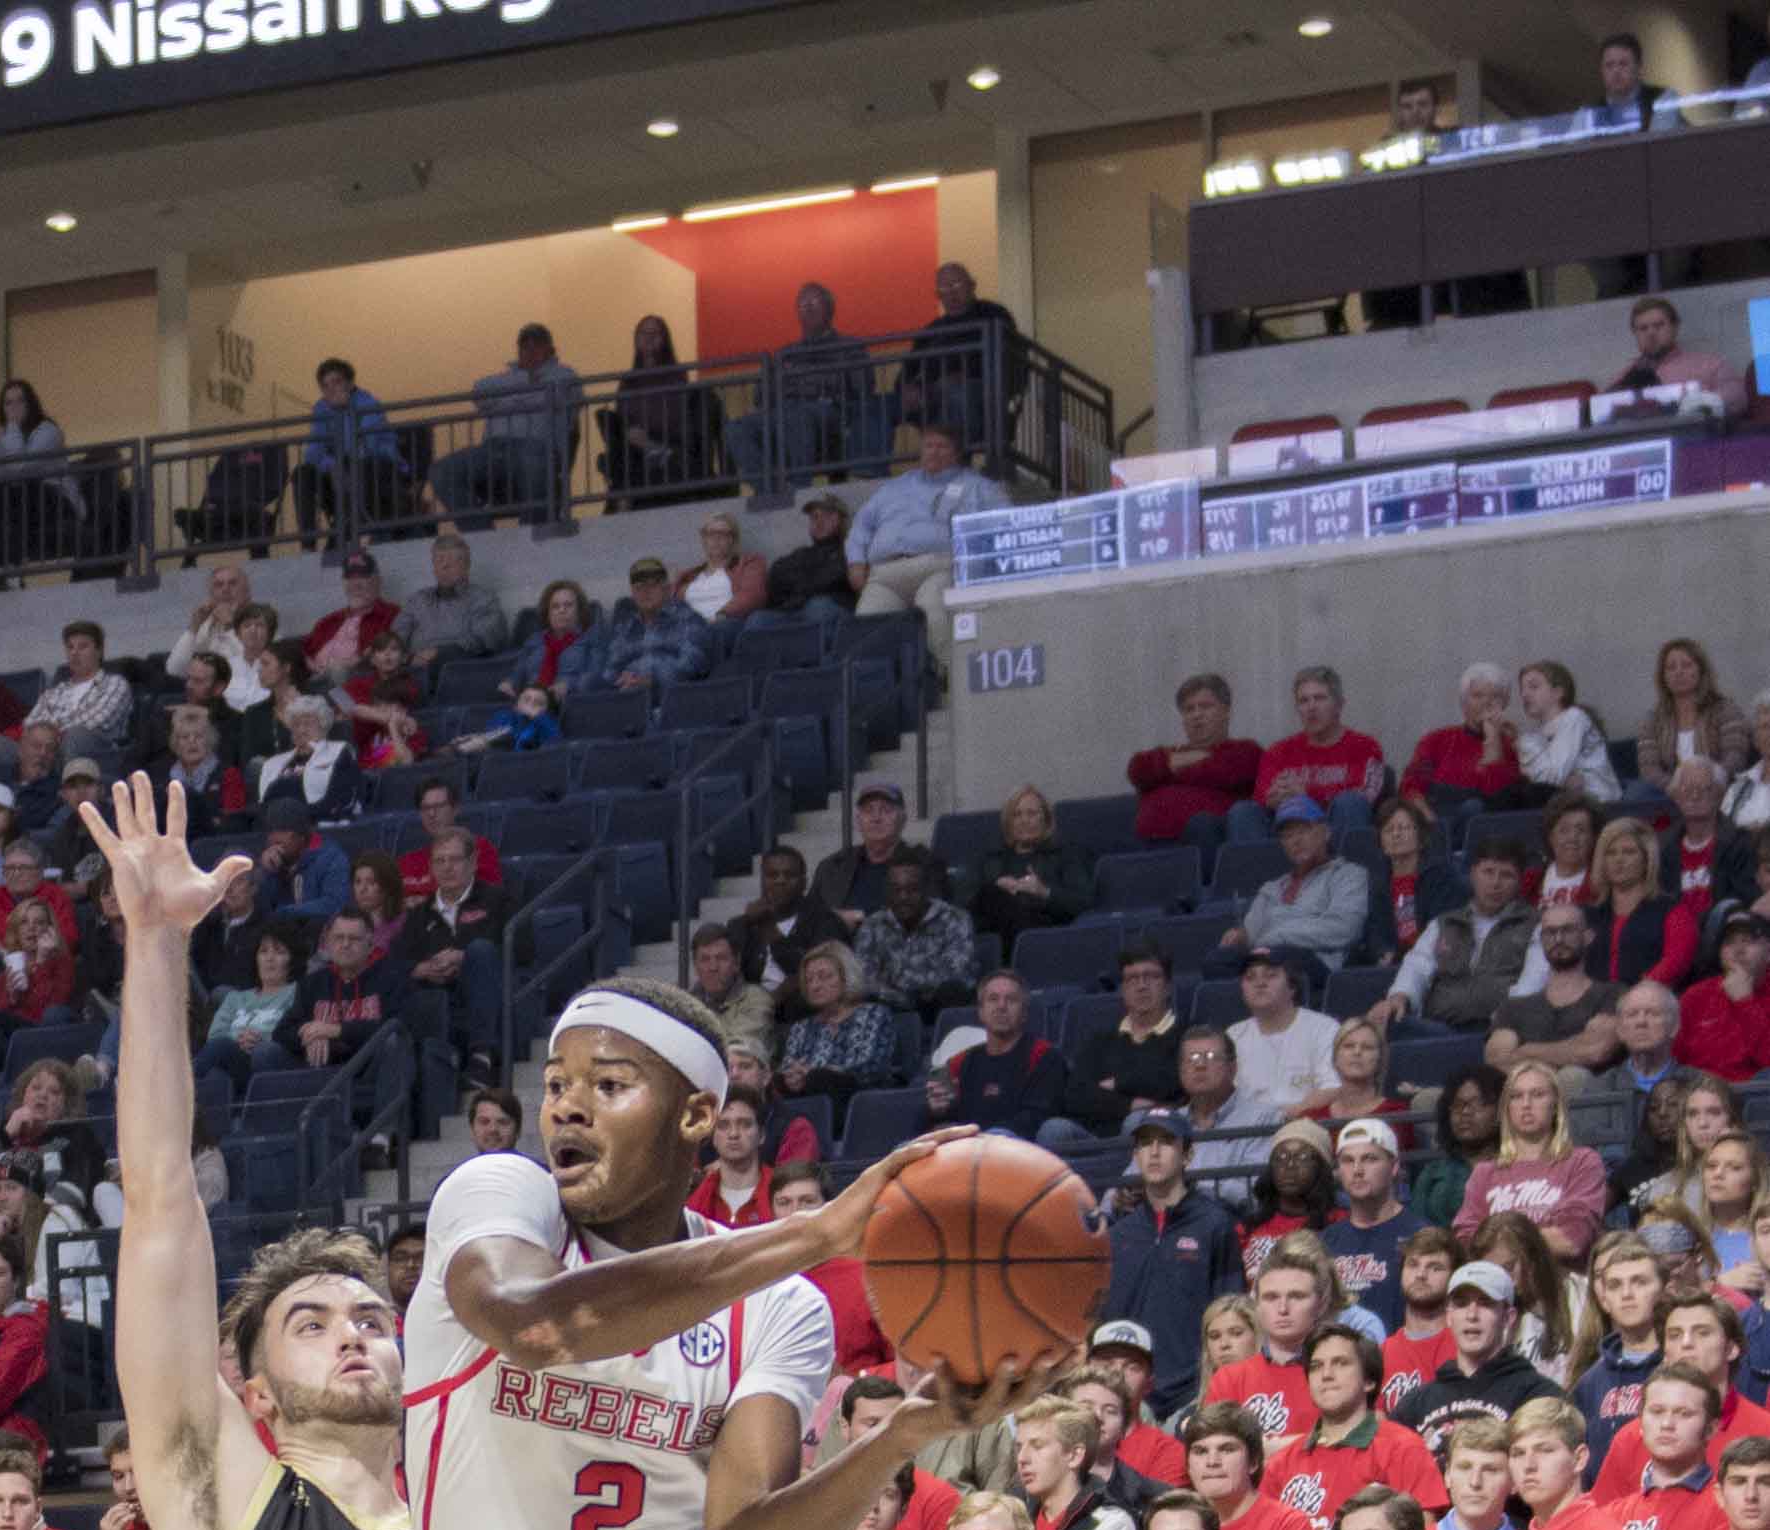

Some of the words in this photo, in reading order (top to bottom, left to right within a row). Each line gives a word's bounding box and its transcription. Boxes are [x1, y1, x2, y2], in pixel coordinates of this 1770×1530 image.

[73, 0, 360, 74] Nissan
[976, 648, 1036, 690] 104
[491, 1360, 727, 1456] REBELS
